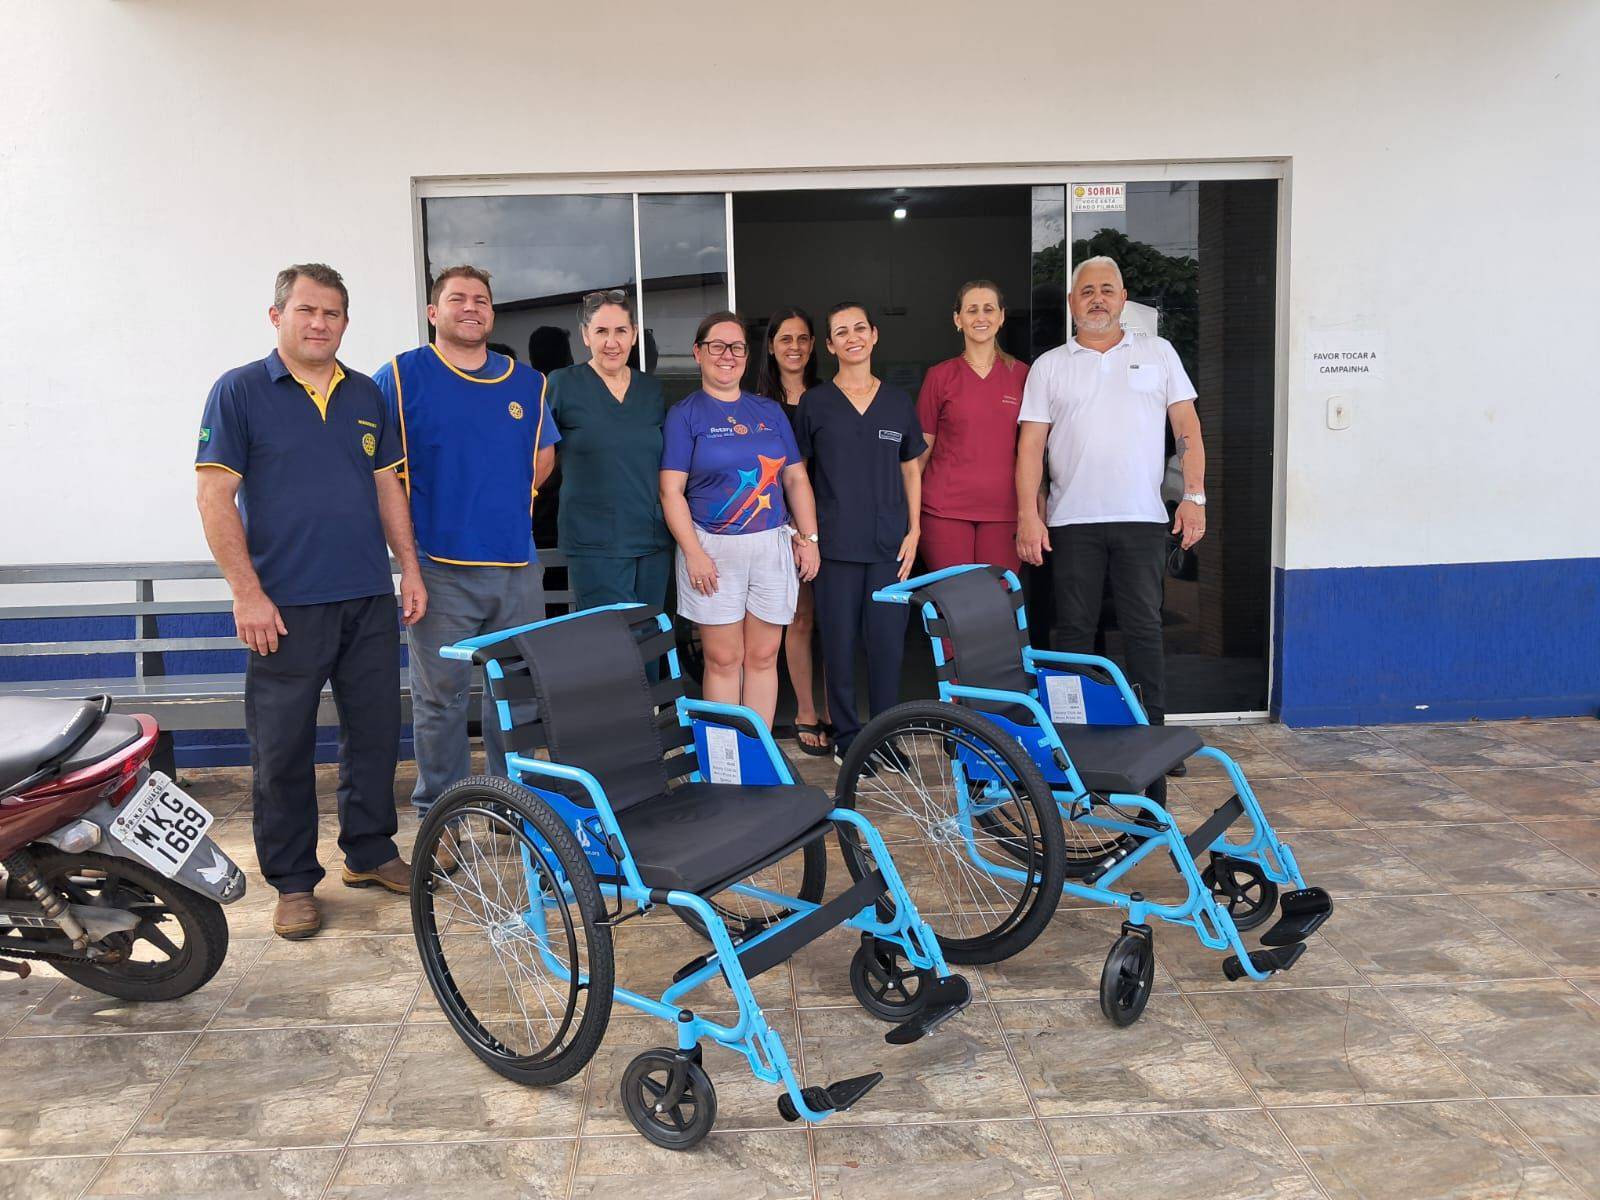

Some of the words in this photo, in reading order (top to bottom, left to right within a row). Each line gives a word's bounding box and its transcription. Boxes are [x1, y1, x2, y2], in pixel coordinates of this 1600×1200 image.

[1313, 352, 1340, 360] FAVOR
[1341, 352, 1369, 360] TOCAR
[1319, 365, 1370, 374] CAMPAINHA
[156, 806, 207, 865] 1669
